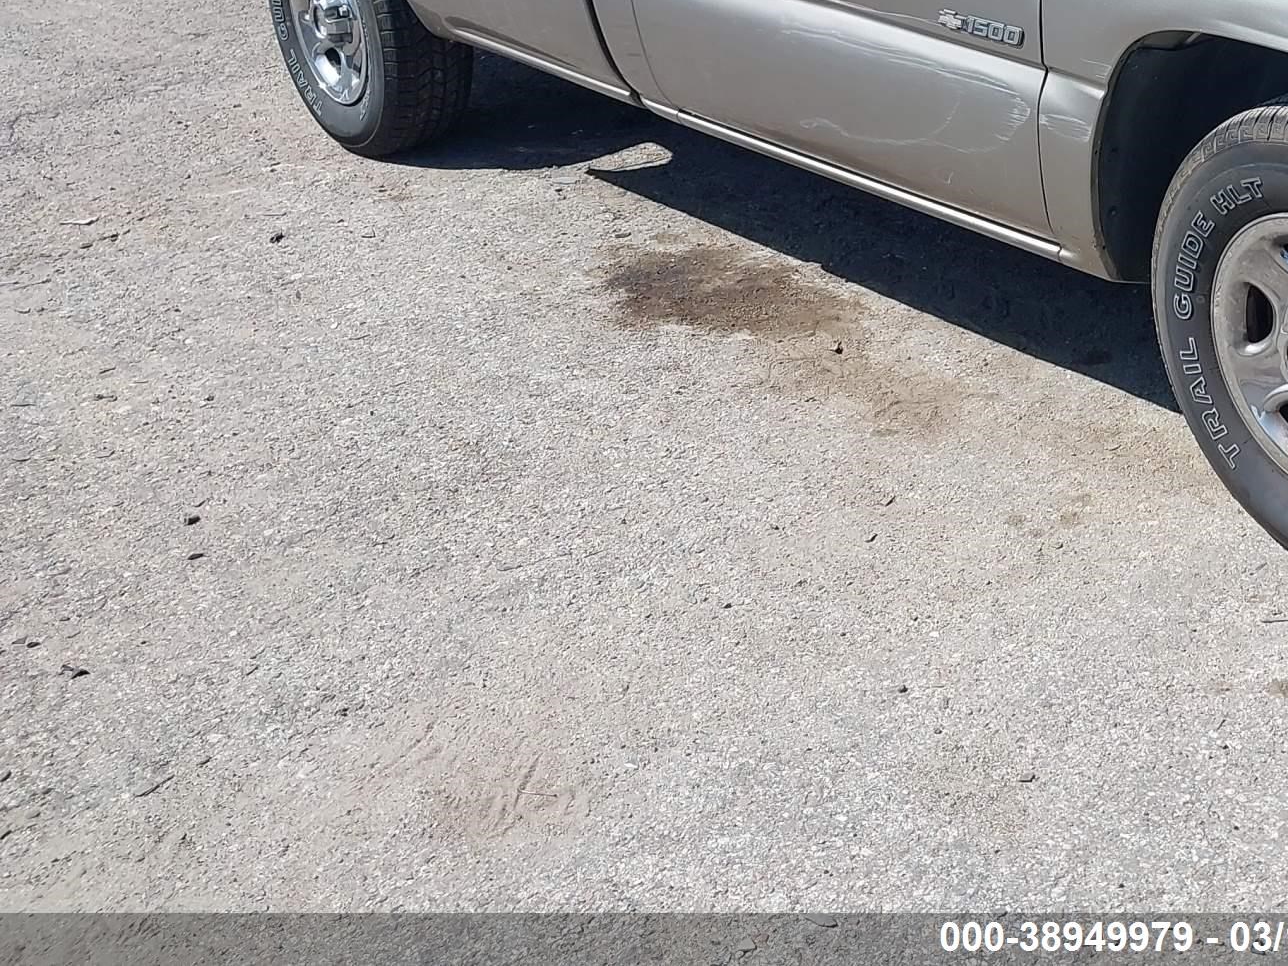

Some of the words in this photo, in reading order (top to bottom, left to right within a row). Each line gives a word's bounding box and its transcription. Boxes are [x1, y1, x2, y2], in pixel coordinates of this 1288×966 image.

[966, 15, 1024, 46] 1500
[288, 48, 323, 117] TRAIL
[1210, 177, 1263, 215] HLT
[1174, 210, 1215, 320] GUIDE
[1180, 337, 1240, 469] TRAIL
